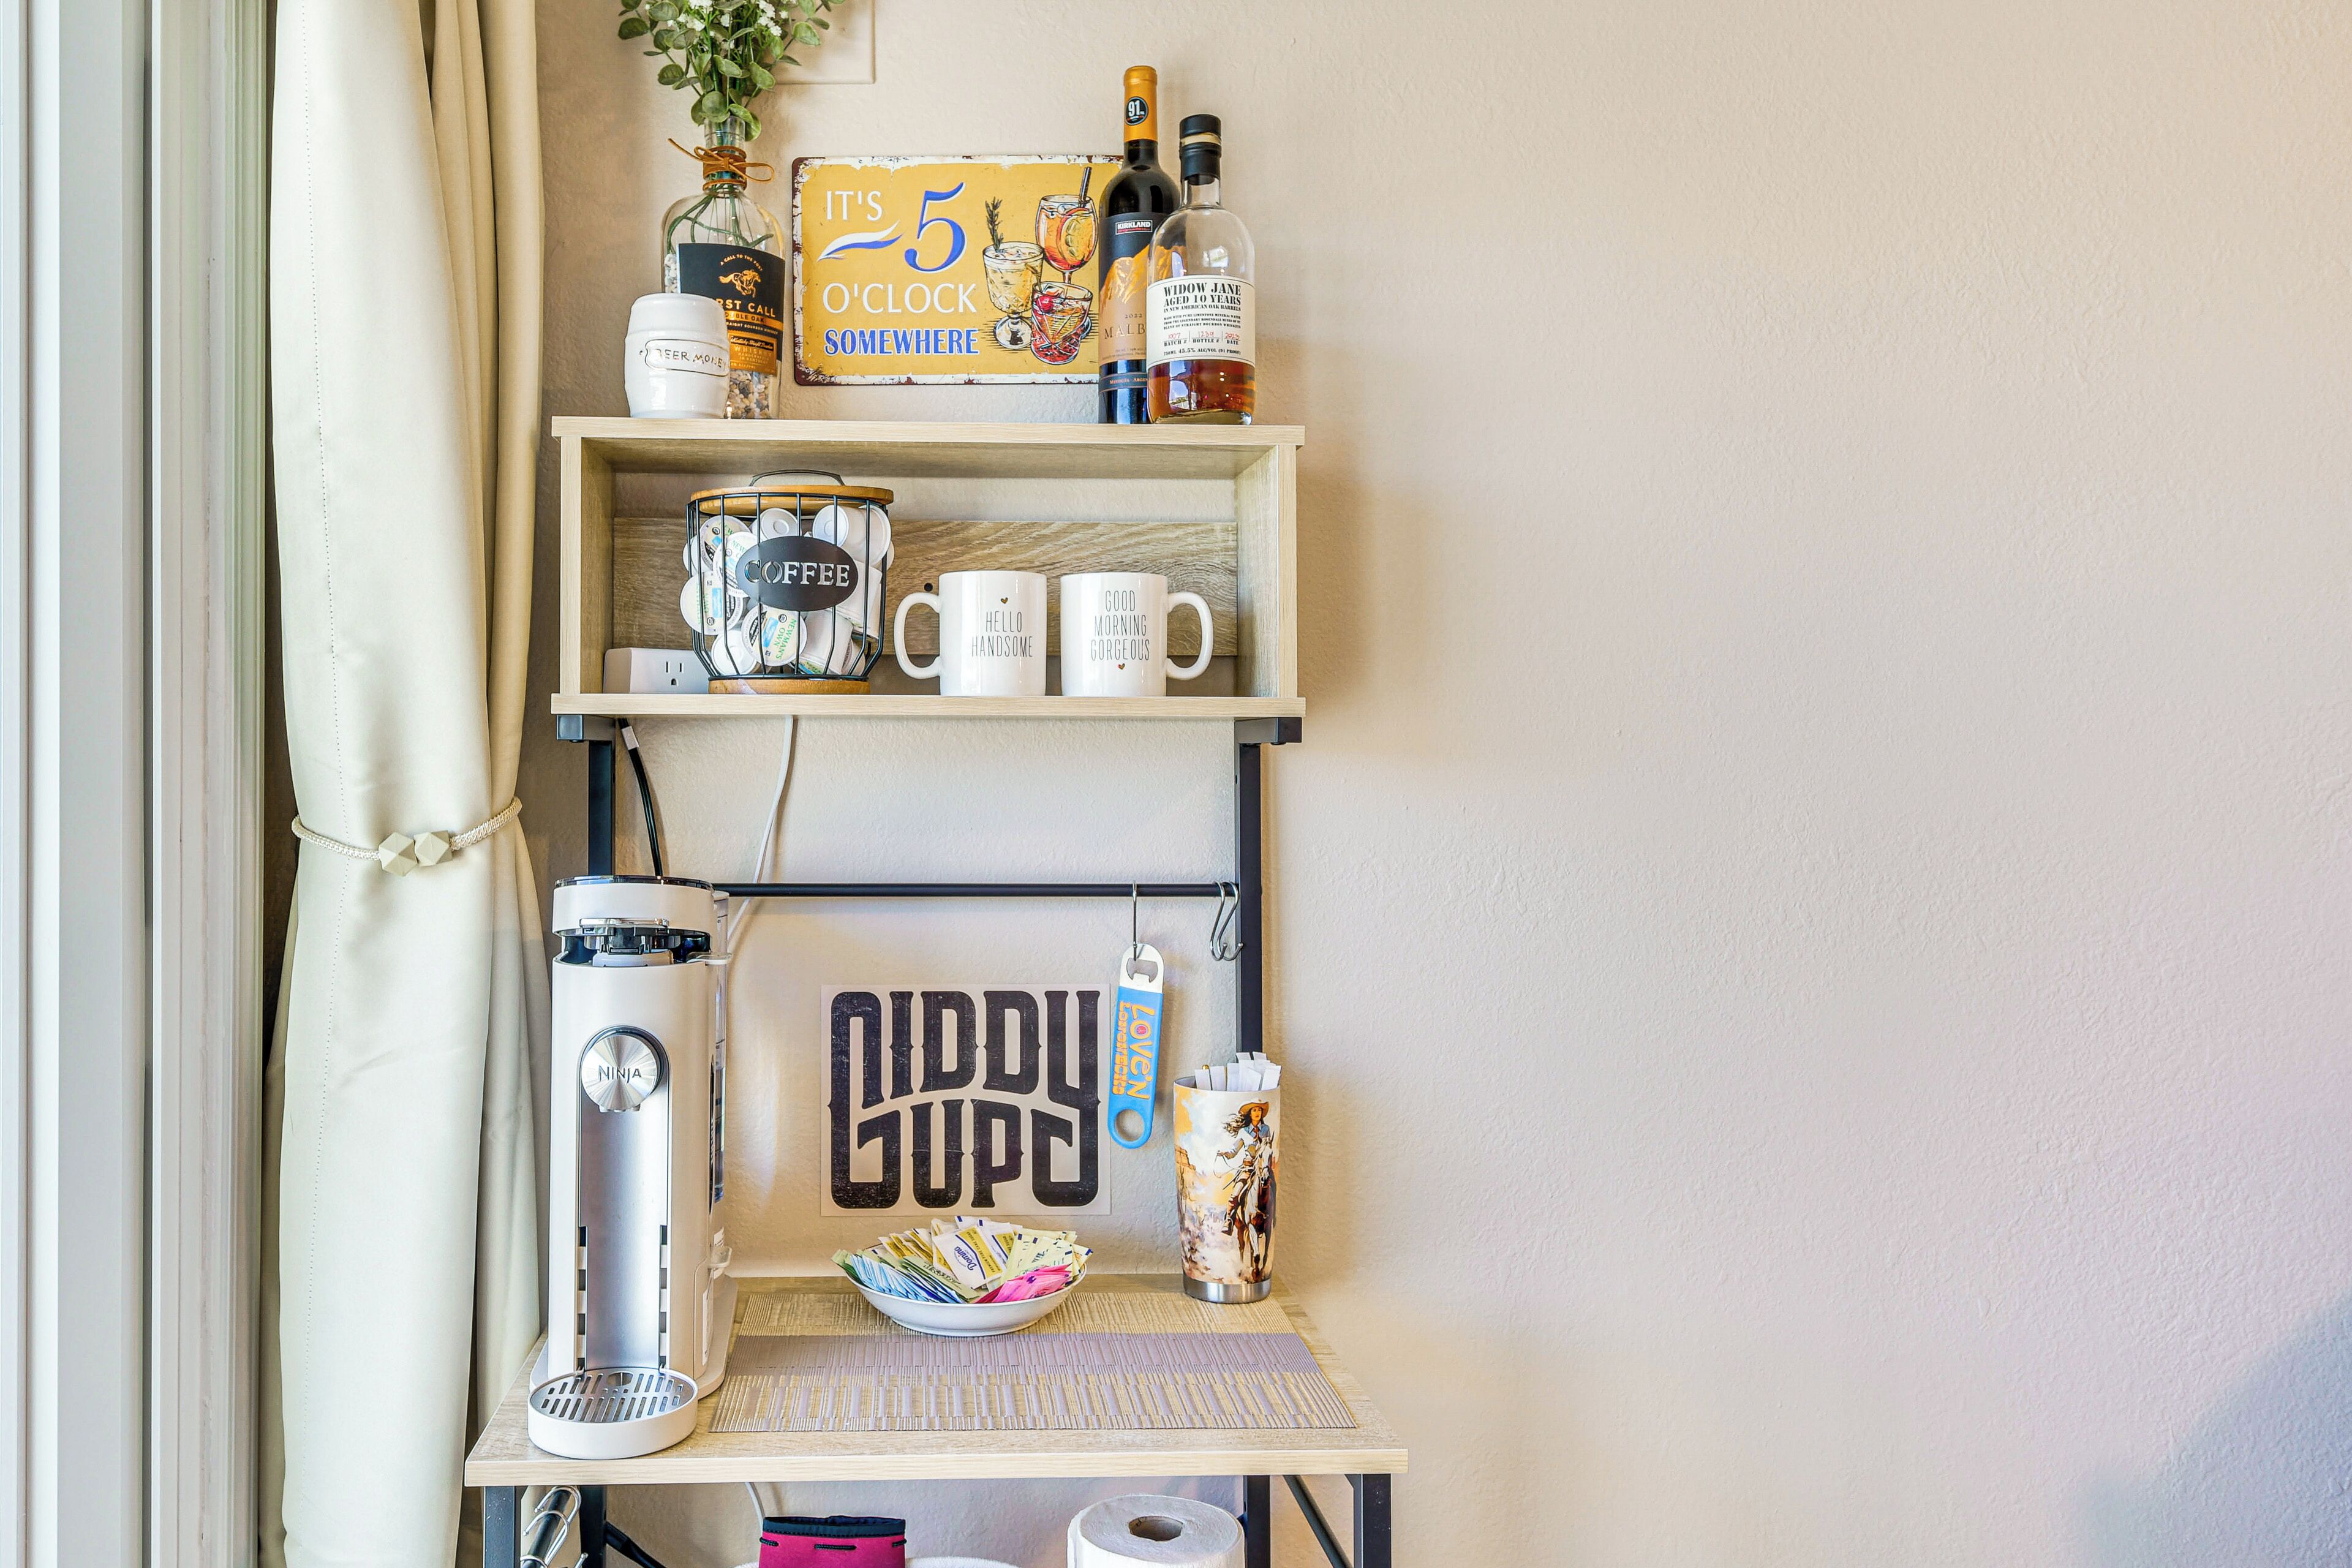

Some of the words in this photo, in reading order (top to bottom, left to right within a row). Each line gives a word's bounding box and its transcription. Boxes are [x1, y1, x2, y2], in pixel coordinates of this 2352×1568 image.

[1128, 100, 1140, 116] 91
[826, 190, 883, 221] IT'S
[903, 181, 967, 274] 5
[1117, 221, 1151, 230] KIRKLAND
[823, 283, 978, 314] O'CLOCK
[1164, 282, 1207, 297] WIDOW
[1212, 283, 1241, 296] JANE
[715, 298, 742, 310] RST
[748, 303, 775, 317] CALL
[1164, 296, 1189, 307] AGED
[1194, 295, 1207, 303] 10
[1210, 295, 1241, 306] YEARS
[1104, 323, 1145, 339] MALB
[824, 328, 980, 356] SOMEWHERE
[744, 559, 850, 587] COFFEE
[1105, 590, 1136, 611] GOOD
[986, 611, 1022, 633] HELLO
[1095, 614, 1147, 636] MORNING
[773, 627, 785, 646] OWN
[776, 619, 797, 659] NEWMAN'S
[971, 636, 1033, 657] HANDSOME
[1090, 639, 1150, 661] GORGEOUS
[598, 1065, 642, 1084] NINJA
[954, 1246, 977, 1270] Domino
